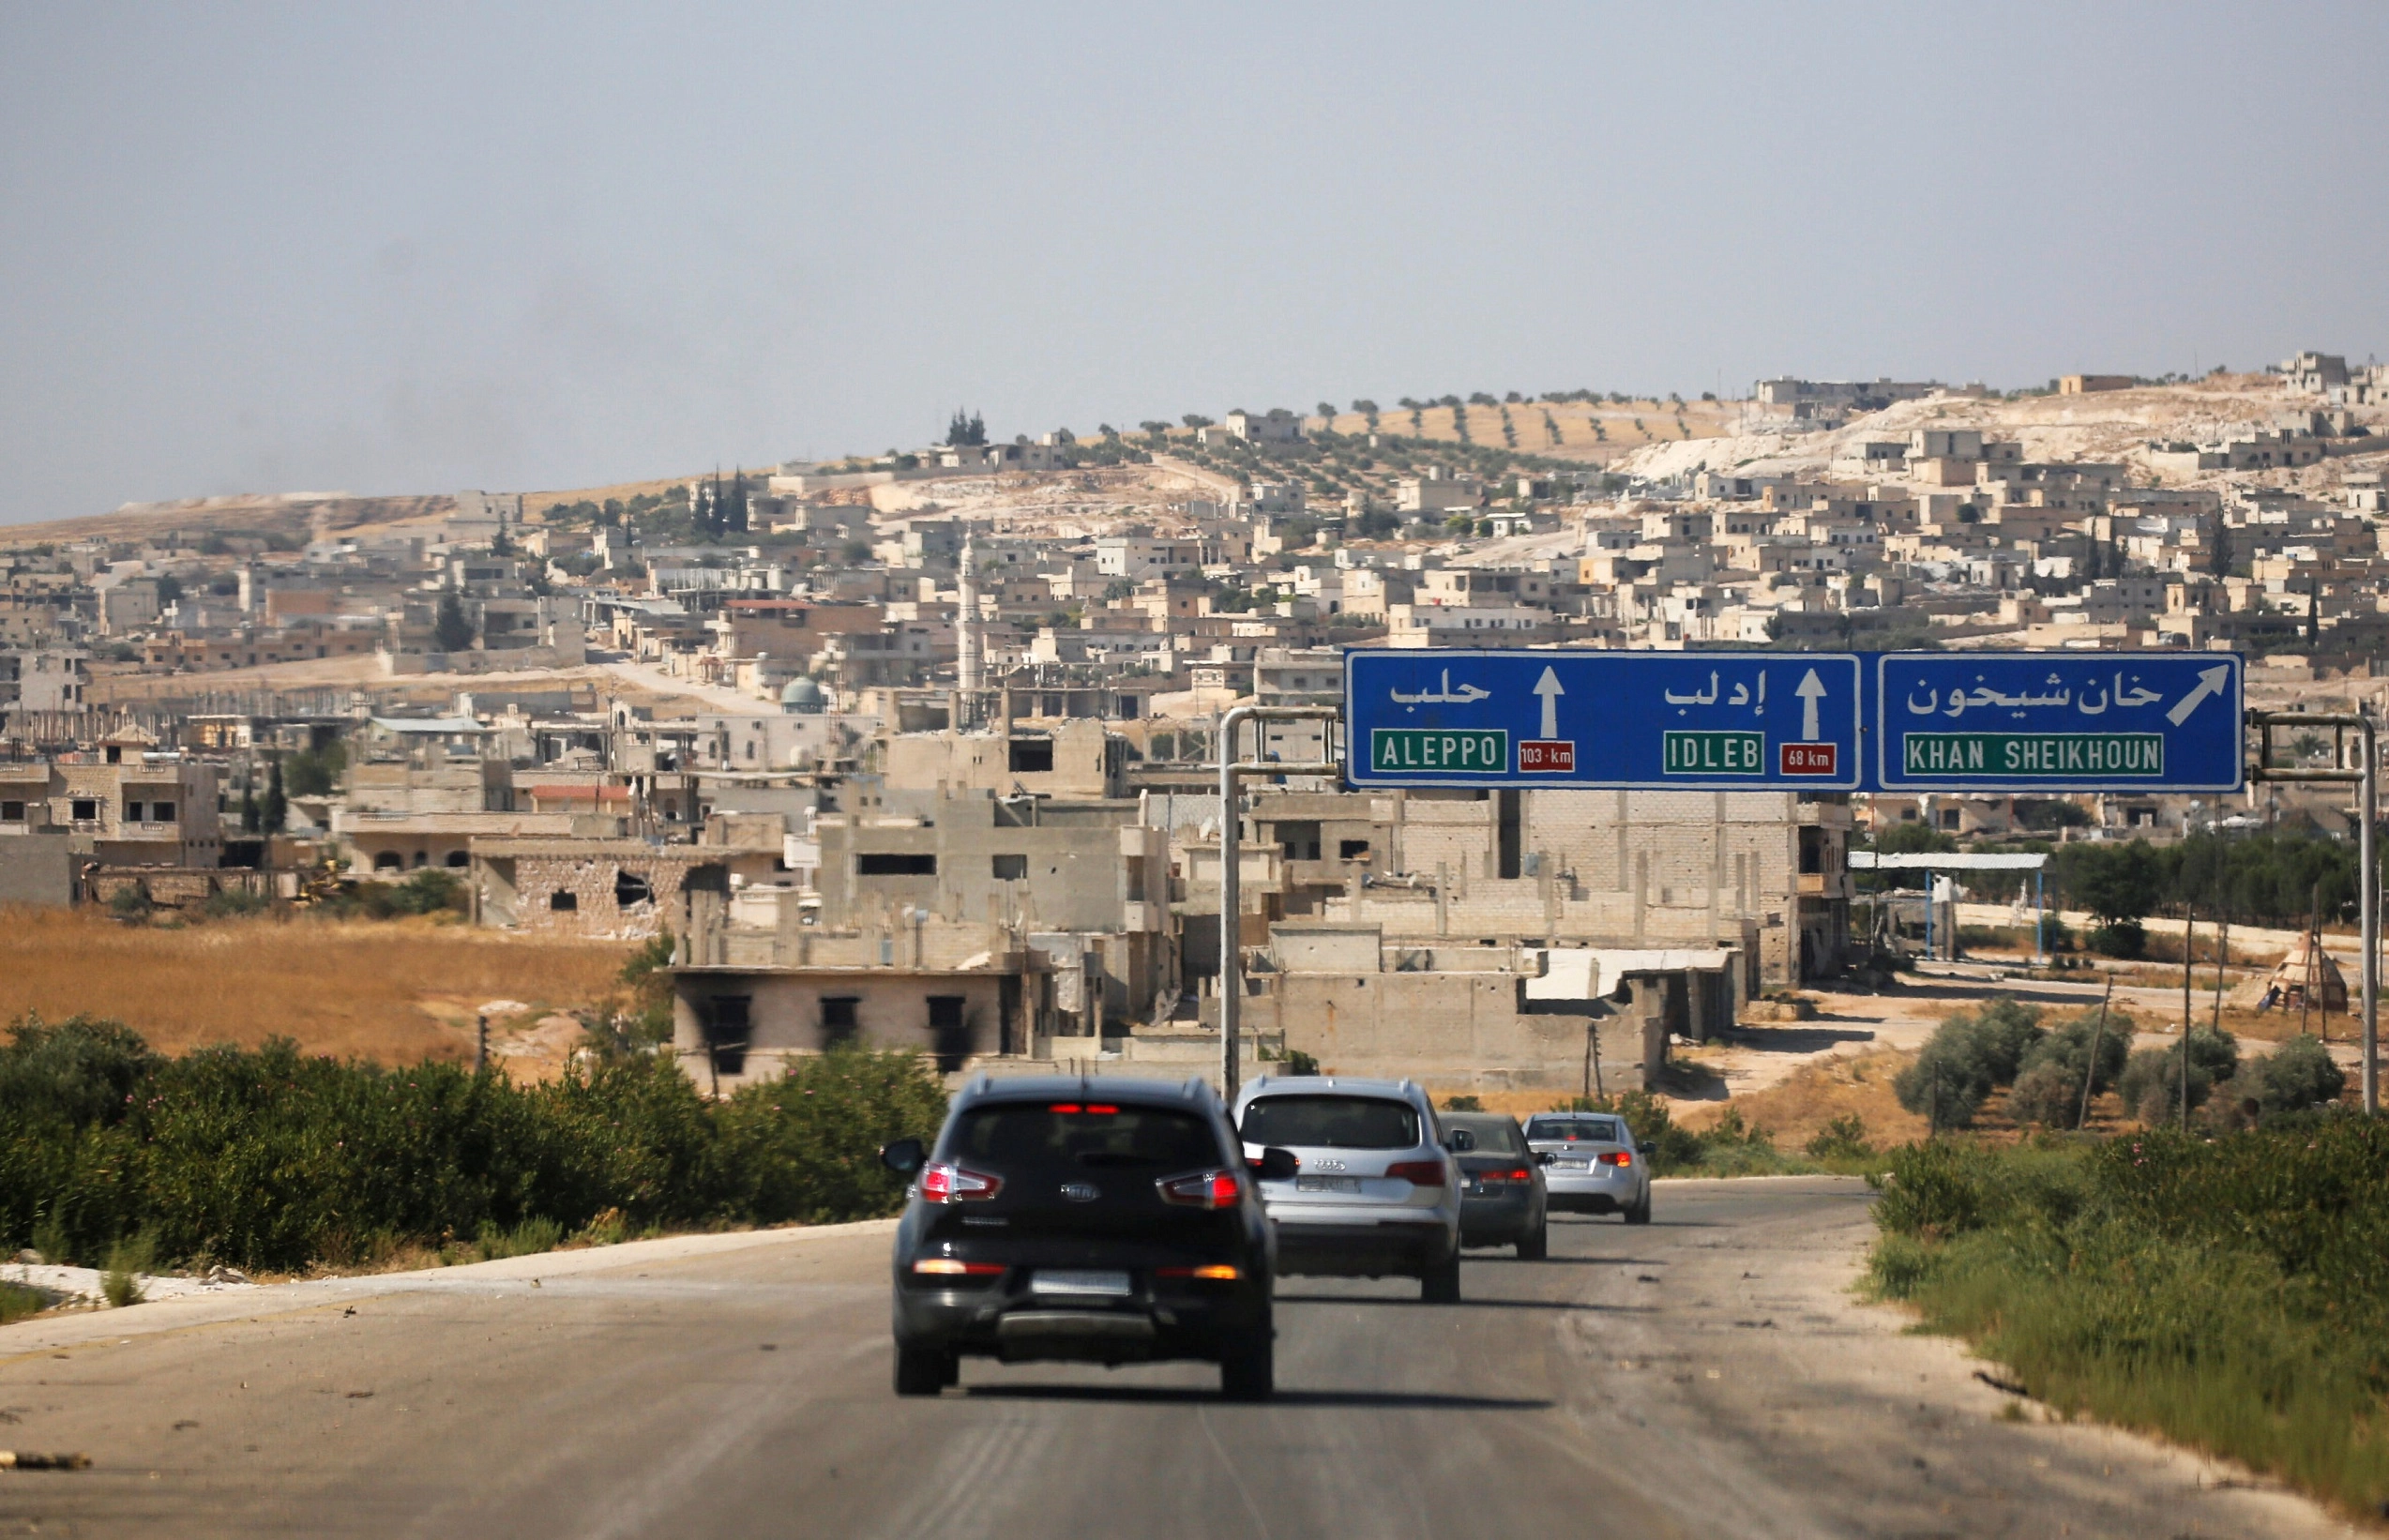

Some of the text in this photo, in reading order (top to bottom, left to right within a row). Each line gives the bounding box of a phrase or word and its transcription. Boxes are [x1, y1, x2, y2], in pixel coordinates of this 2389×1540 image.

[1390, 668, 1491, 713] حلب
[1664, 669, 1766, 717] إدلب
[1907, 671, 2164, 718] خان شيخون
[1382, 736, 1497, 765] ALEPPO
[1521, 748, 1571, 763] 103 km
[1671, 738, 1759, 768] IDLEB
[1788, 750, 1829, 766] 68 km
[1909, 740, 2158, 769] KHAN SHEIKHOUN
